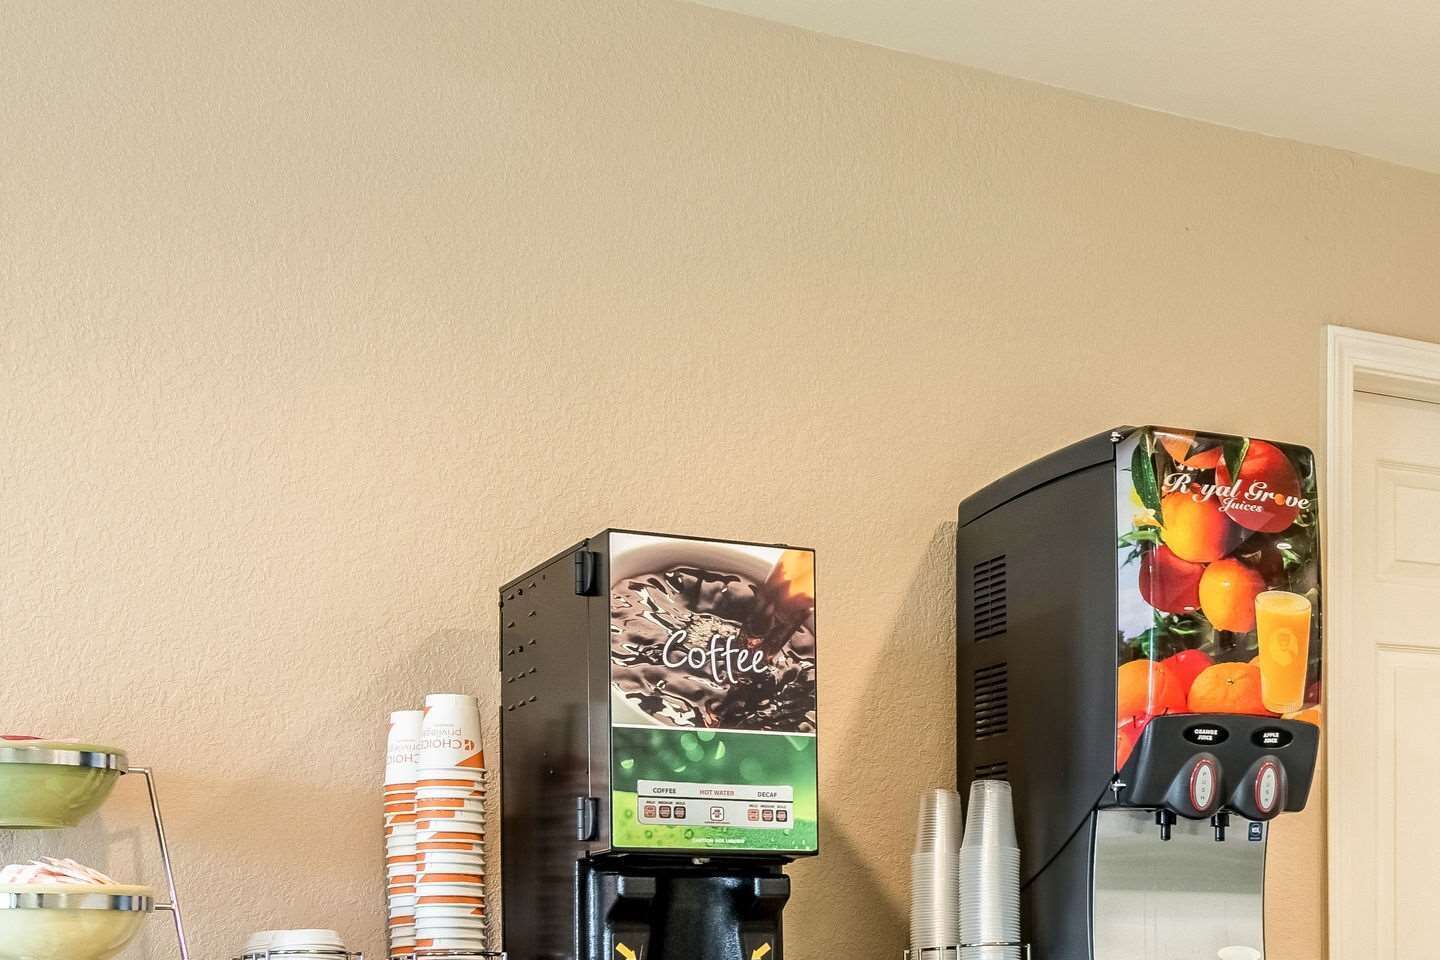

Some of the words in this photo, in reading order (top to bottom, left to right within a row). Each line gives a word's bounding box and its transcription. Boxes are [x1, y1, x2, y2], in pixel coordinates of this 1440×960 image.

[1161, 472, 1242, 503] Royal
[1244, 481, 1311, 510] Grove
[1218, 497, 1264, 513] Juices
[662, 629, 769, 685] Coffee
[425, 739, 462, 750] CHOIC
[714, 789, 736, 797] WATER
